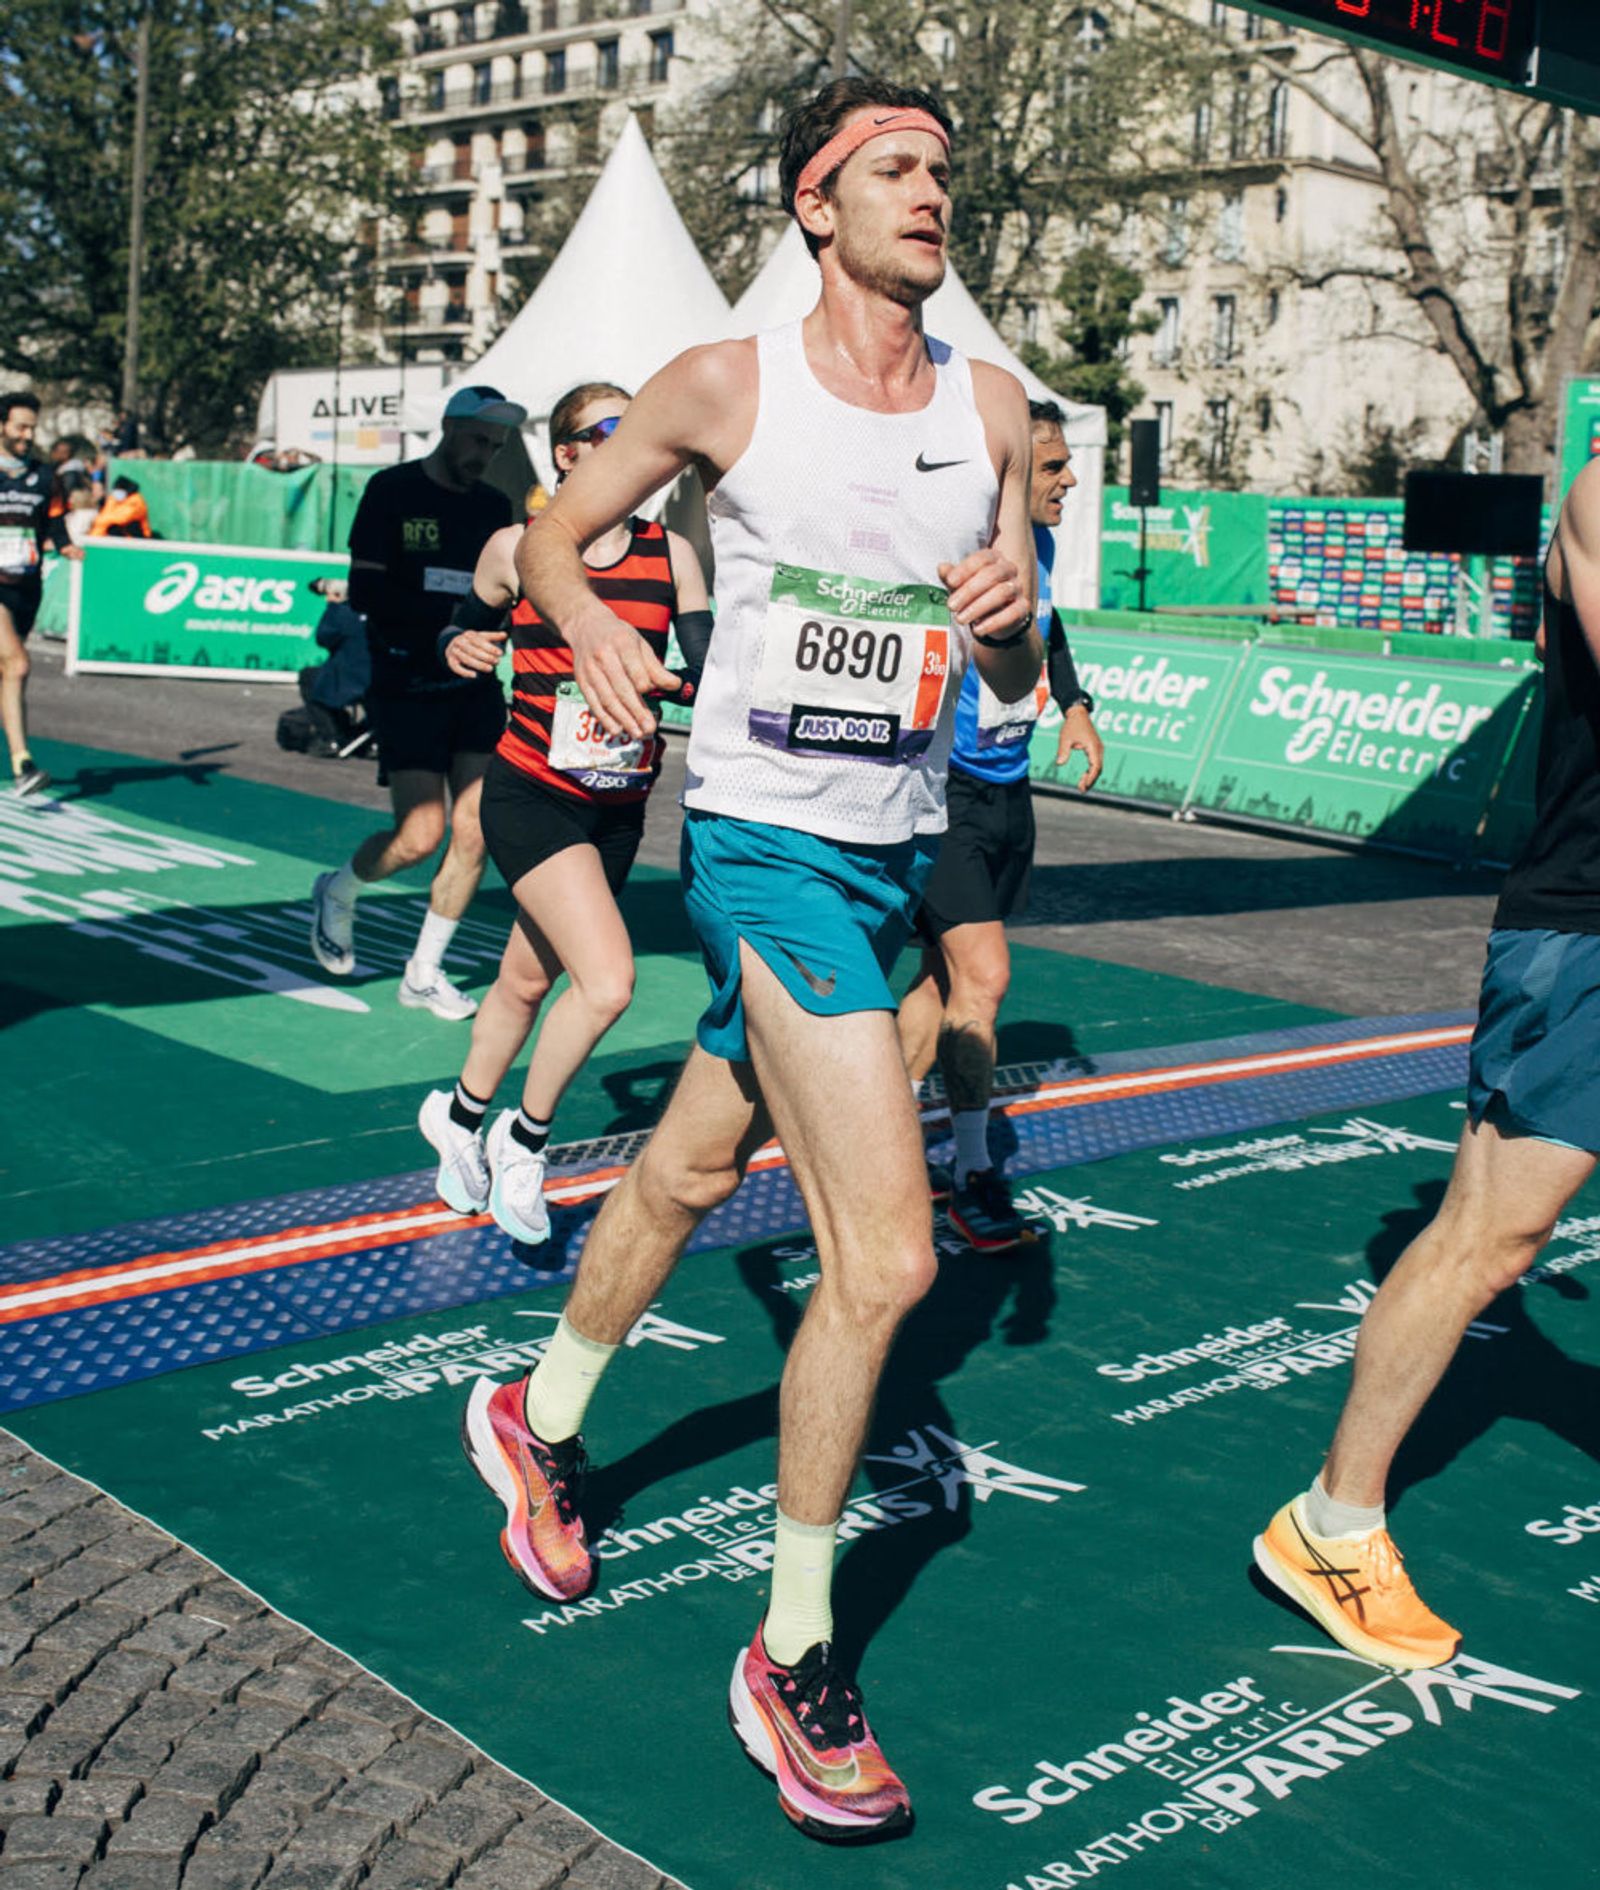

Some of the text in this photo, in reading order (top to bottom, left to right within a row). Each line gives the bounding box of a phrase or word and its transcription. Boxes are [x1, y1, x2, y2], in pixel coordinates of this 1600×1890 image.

[194, 574, 296, 614] asics
[816, 578, 915, 607] Schneider
[859, 602, 911, 618] Electric
[795, 620, 903, 684] 6890
[1076, 655, 1210, 709] neider
[1250, 666, 1494, 743] Schneider
[795, 714, 841, 742] JUST
[842, 717, 869, 742] DO
[1093, 701, 1186, 742] lectric
[1326, 730, 1466, 781] Electric
[231, 1324, 488, 1397] Schneider
[368, 1338, 514, 1378] Electric
[1096, 1316, 1294, 1383] Schneider
[1211, 1329, 1323, 1367] Electric
[201, 1379, 400, 1441] MARATHON
[1111, 1369, 1261, 1425] MARATHON
[595, 1483, 778, 1560] chneide
[691, 1513, 778, 1546] Elec
[521, 1494, 932, 1634] MARATHON DE PRIS
[973, 1676, 1265, 1824] Schneider
[1144, 1701, 1308, 1780] Electric
[1006, 1700, 1413, 1890] ARATHON DE PARIS
